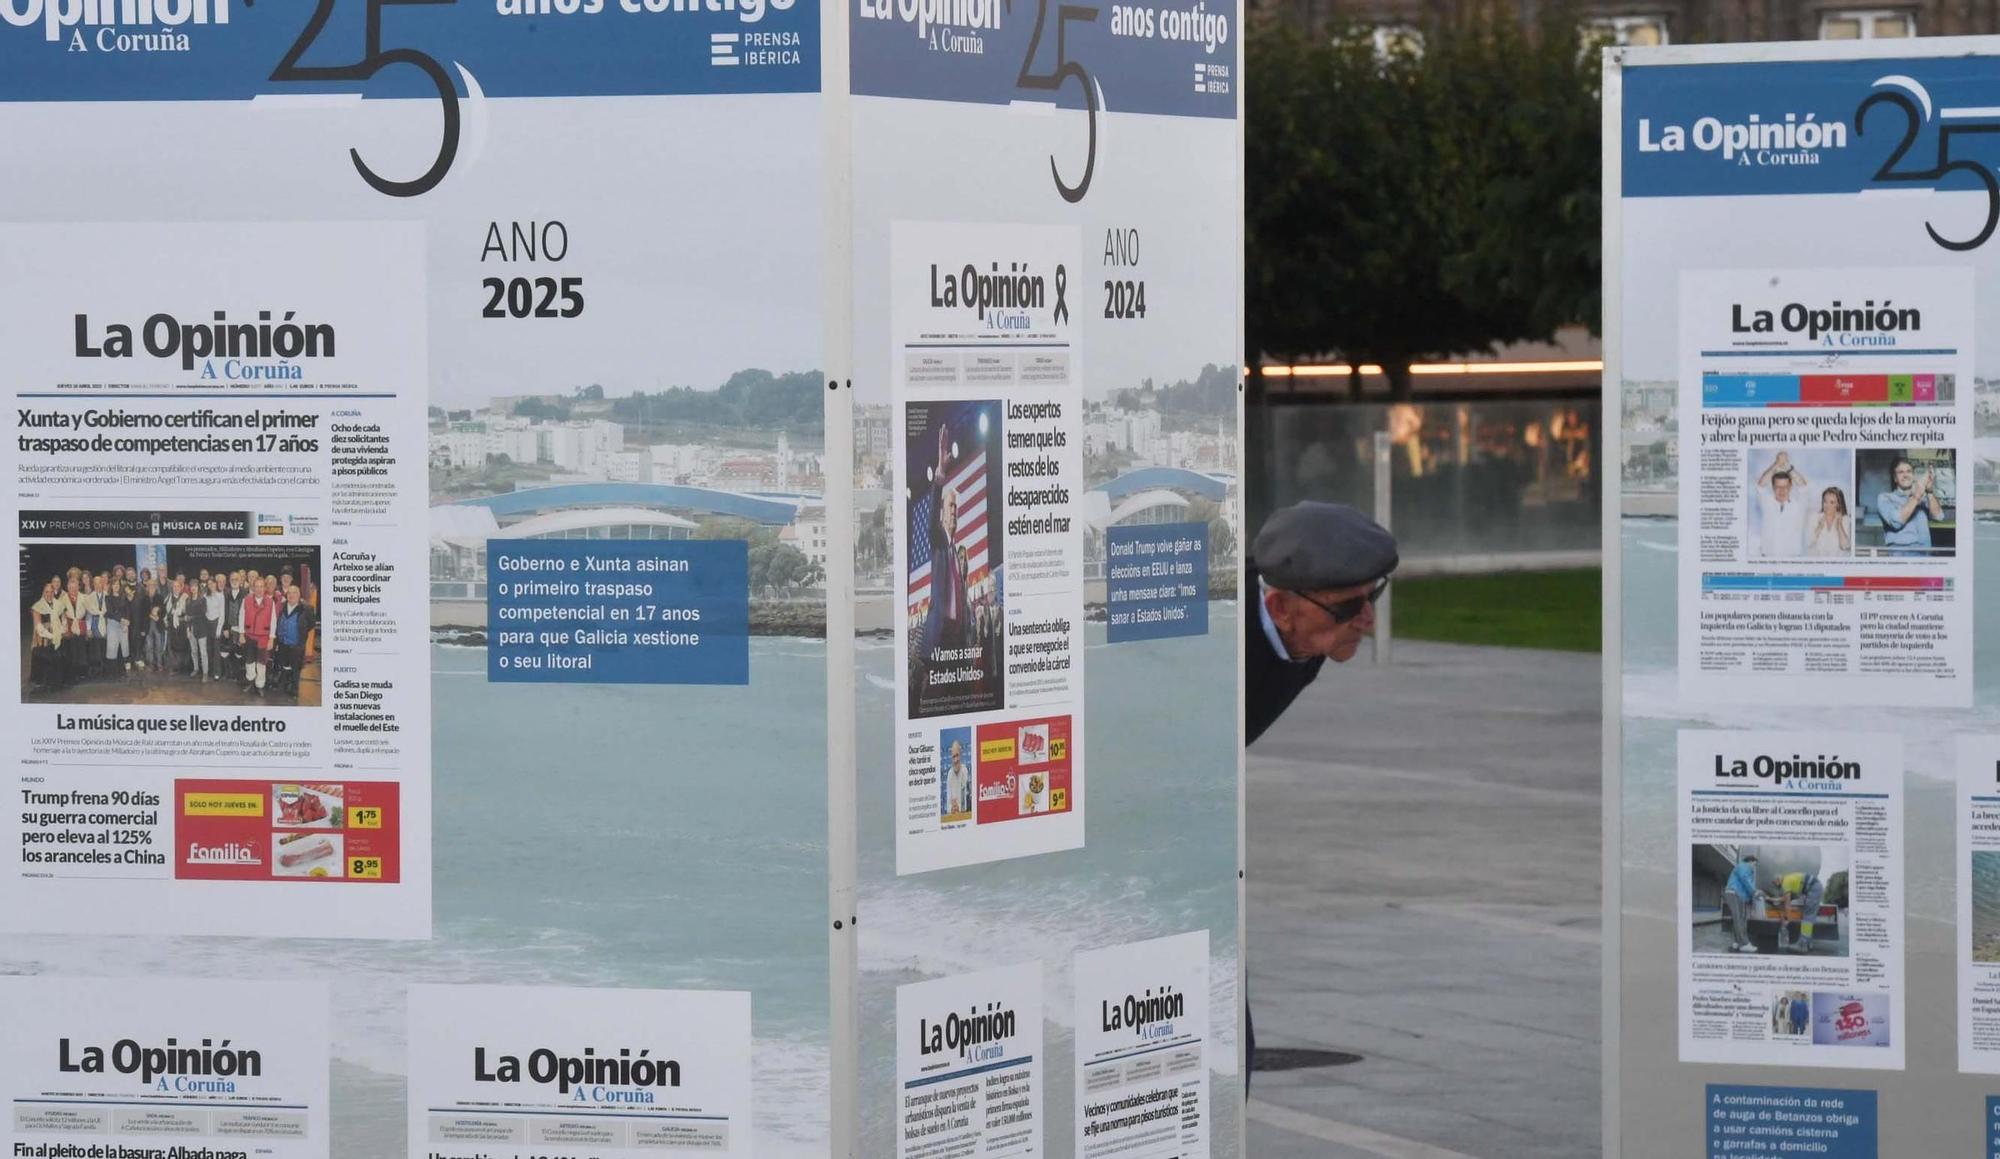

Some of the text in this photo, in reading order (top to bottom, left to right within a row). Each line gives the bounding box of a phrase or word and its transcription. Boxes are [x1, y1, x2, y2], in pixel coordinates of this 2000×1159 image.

[1110, 4, 1229, 54] anos contigo
[67, 27, 191, 52] A Coruña
[744, 32, 801, 46] PRENSA
[928, 28, 984, 54] A Coruña
[744, 49, 801, 65] IBÉRICA
[1638, 112, 1847, 160] La Opinión
[1737, 150, 1820, 166] A Coruña
[1854, 91, 2000, 251] 25
[481, 220, 568, 262] ANO
[1103, 228, 1139, 267] ANO
[482, 277, 585, 319] 2025
[931, 261, 1044, 320] La Opinión
[1104, 280, 1146, 319] 2024
[986, 309, 1031, 330] A Coruña
[1732, 300, 1921, 340] La Opinión
[75, 311, 335, 370] La Opinión
[1822, 332, 1897, 347] A Coruña
[201, 359, 303, 380] A Coruña
[18, 409, 319, 431] Xunta y Gobierno certifican el primer
[1007, 399, 1062, 423] Los expertos
[1700, 412, 1957, 429] Feijóo gana pero se queda lejos de la mayoría
[18, 434, 319, 455] traspaso de competencias en 17 años
[1007, 426, 1066, 452] temen que los
[1007, 455, 1059, 477] restos de los
[1007, 483, 1069, 510] desaparecidos
[21, 519, 244, 531] XXIV PREMIOS OPINIÓN DA MÚSICA DE RAÍZ
[1008, 511, 1070, 535] estén en el mar
[1110, 538, 1202, 557] Donald Trump volve gañar as
[498, 555, 689, 573] Goberno e Xunta asinan
[1111, 561, 1193, 579] eleccións en EEUU e lanza
[499, 580, 653, 599] o primeiro traspaso
[1111, 586, 1128, 602] unha
[1129, 588, 1158, 600] mensaxe
[1158, 584, 1177, 598] clara:
[499, 605, 700, 623] competencial en 17 anos
[1111, 611, 1130, 625] sanar
[1130, 612, 1136, 623] a
[1136, 607, 1162, 623] Estados
[499, 629, 700, 648] para que Galicia xestione
[499, 653, 592, 669] o seu litoral
[1715, 754, 1861, 785] La Opinión
[22, 790, 160, 807] Trump frena 90 días
[22, 811, 157, 826] su guerra comercial
[22, 829, 152, 846] pero eleva al 125%
[22, 848, 165, 865] los aranceles a China
[59, 1037, 261, 1084] La Opinión
[474, 1047, 681, 1094] La Opinión
[156, 1075, 236, 1093] A Coruña
[572, 1086, 655, 1104] A Coruña
[1712, 1093, 1844, 1109] A contaminación da rede
[1712, 1108, 1860, 1127] de auga de Betanzos obriga
[1713, 1123, 1839, 1139] a usar camións cisterna
[1713, 1139, 1828, 1152] e garrafas a domicilio
